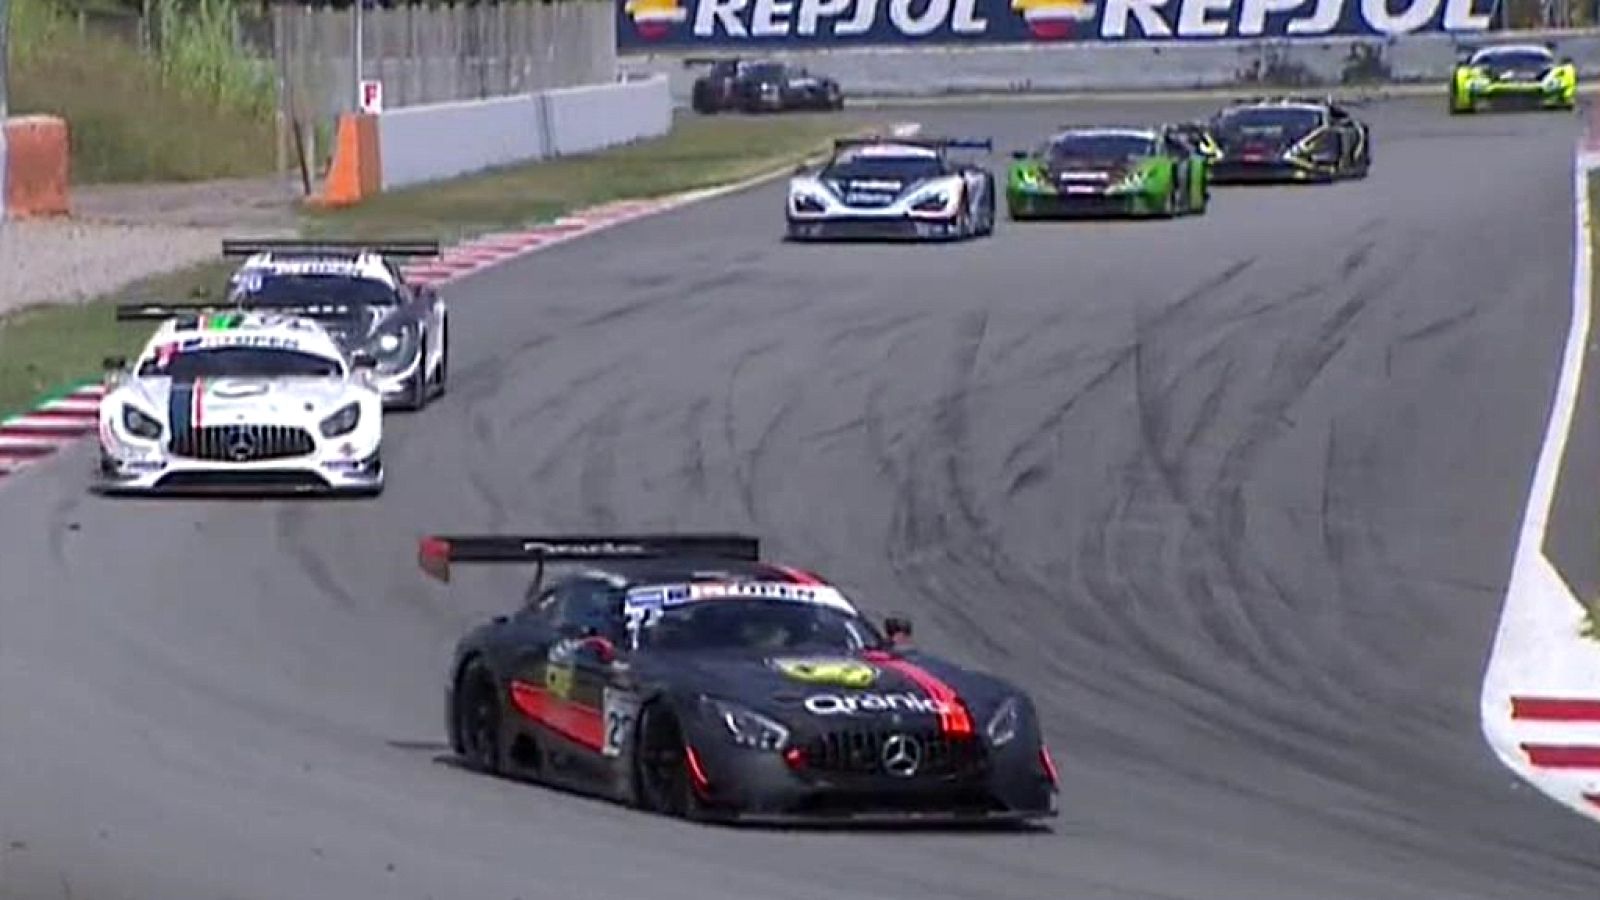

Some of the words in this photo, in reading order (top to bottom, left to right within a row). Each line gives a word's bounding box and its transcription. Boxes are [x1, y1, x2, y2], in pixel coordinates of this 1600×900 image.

[693, 0, 989, 37] REPSOL
[1100, 0, 1494, 38] REPSOL
[364, 84, 377, 107] F
